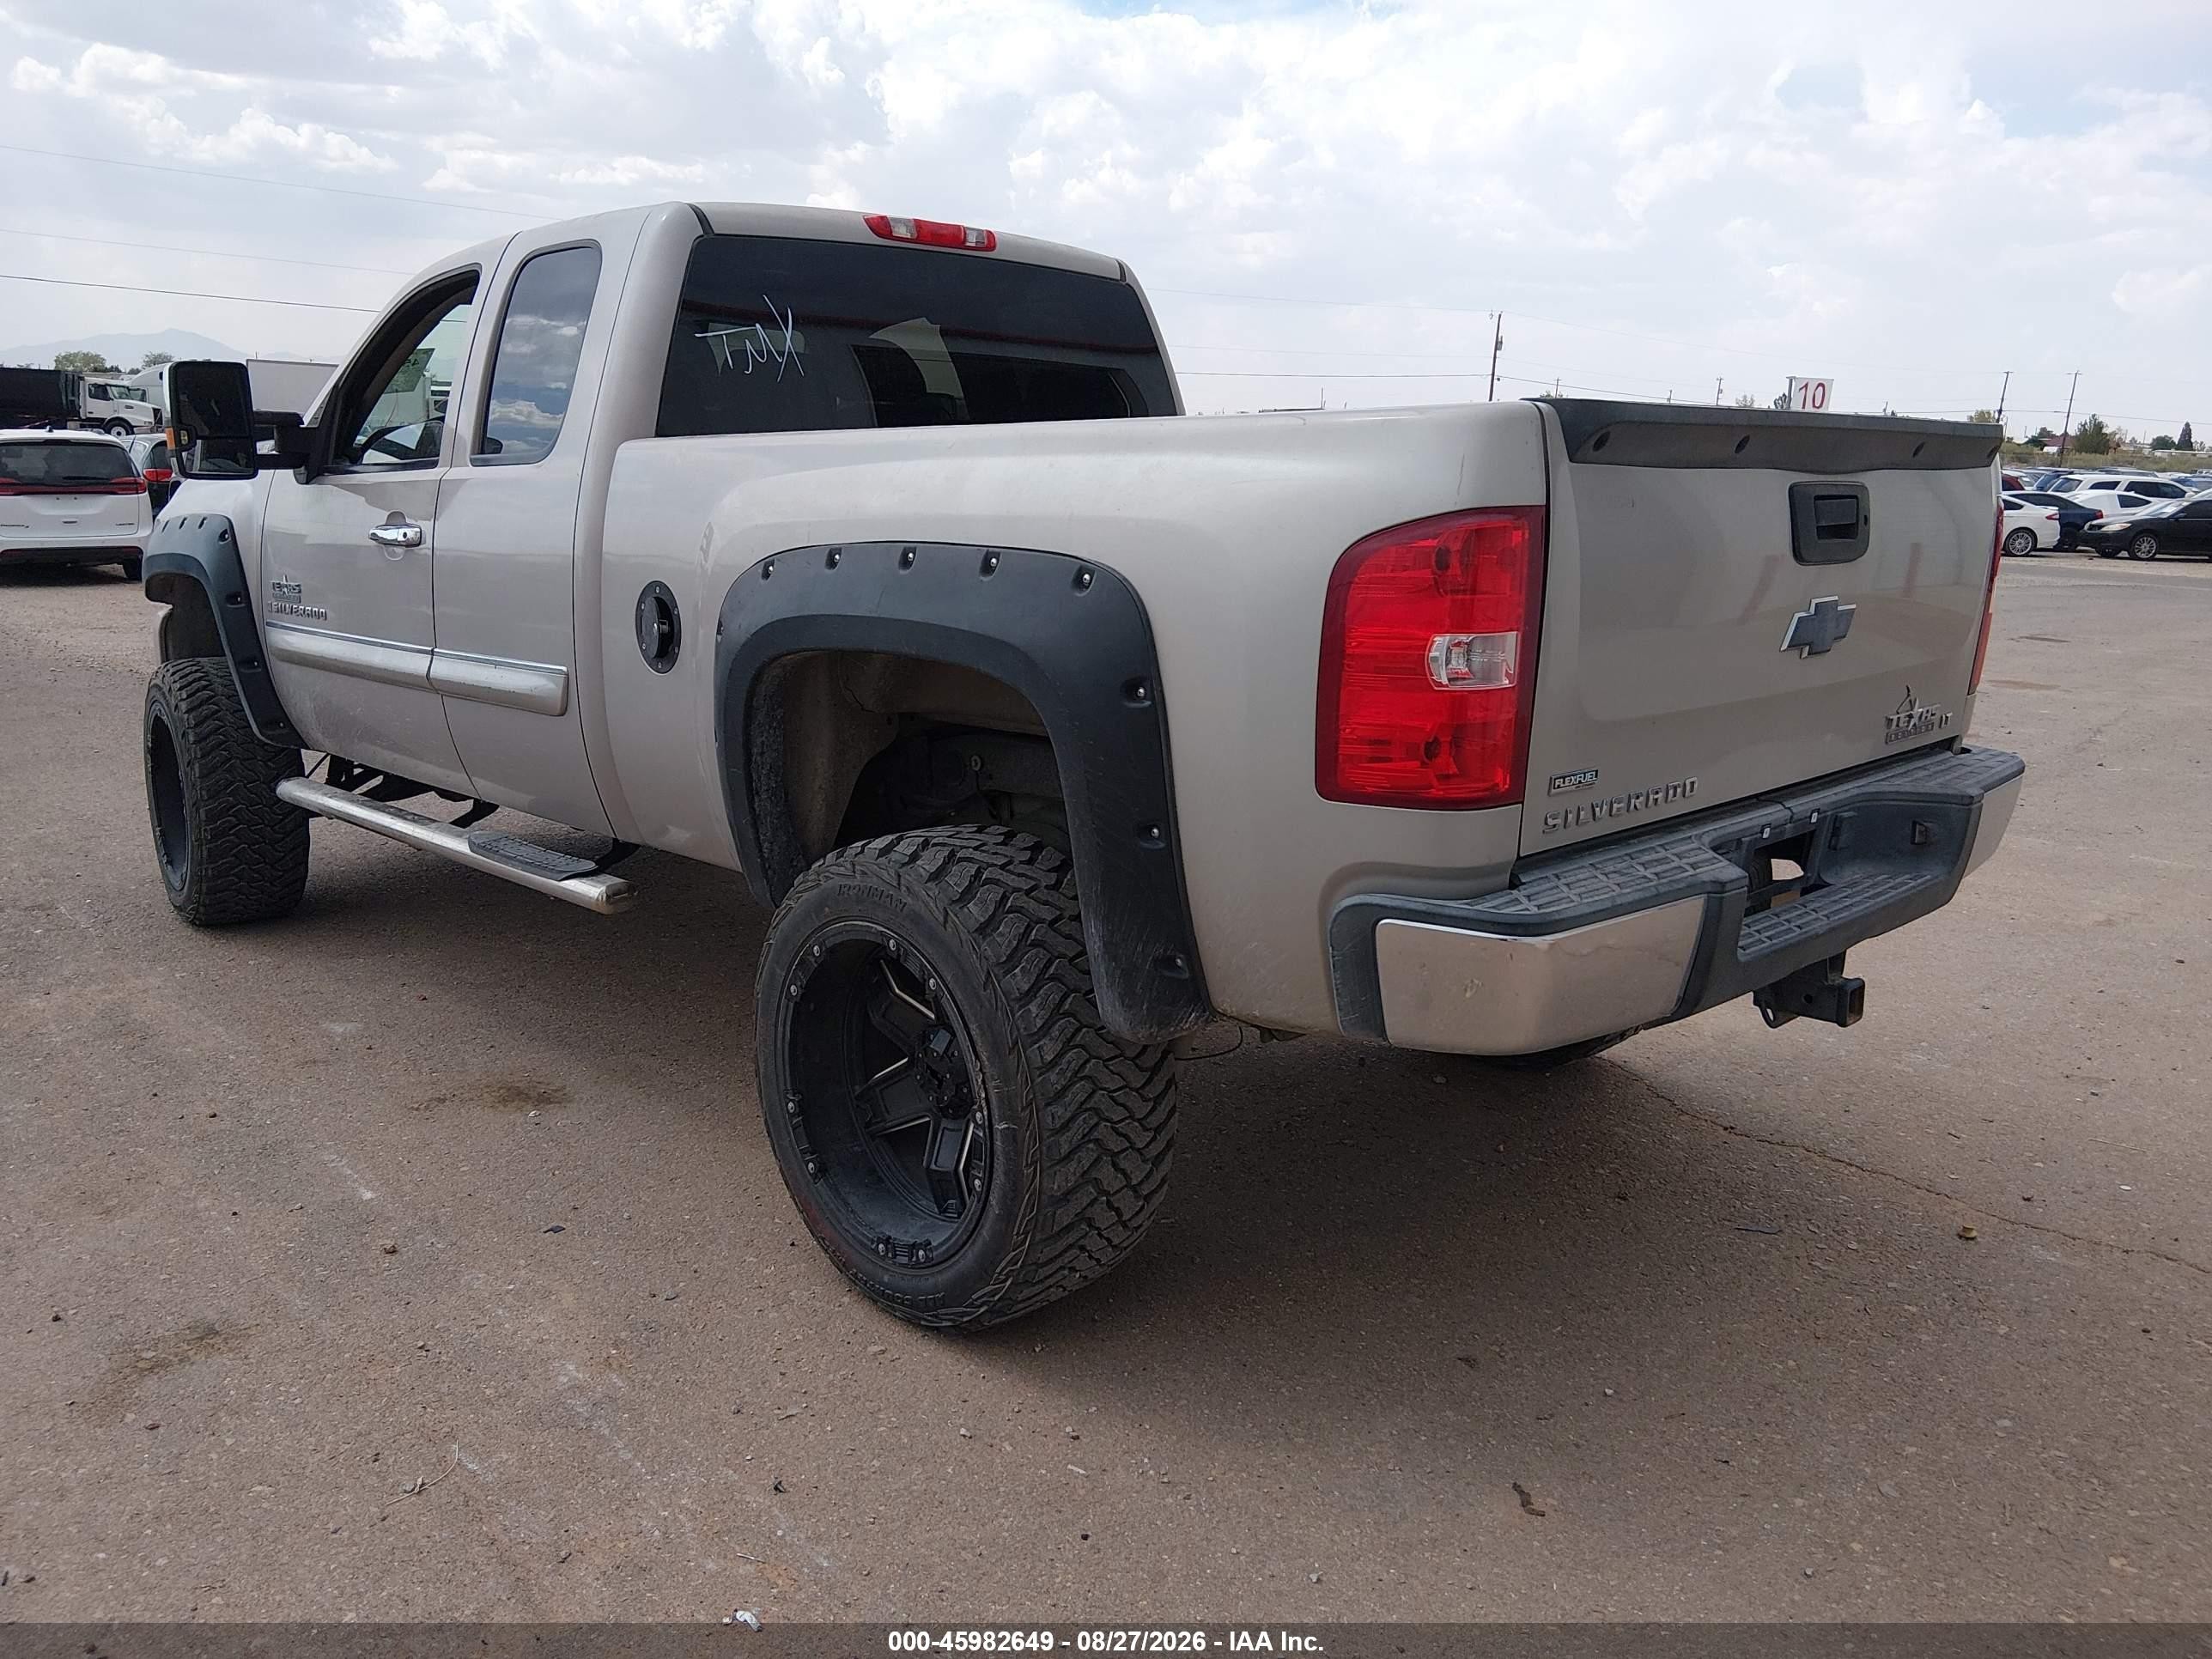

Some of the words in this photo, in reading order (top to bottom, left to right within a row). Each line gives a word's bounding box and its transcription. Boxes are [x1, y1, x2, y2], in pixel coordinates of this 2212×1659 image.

[1799, 381, 1826, 410] 10
[268, 601, 328, 620] SILVERADO
[1884, 700, 1941, 730] TEXAS
[1542, 776, 1698, 835] SILVERADO
[837, 883, 908, 912] IRONMAN
